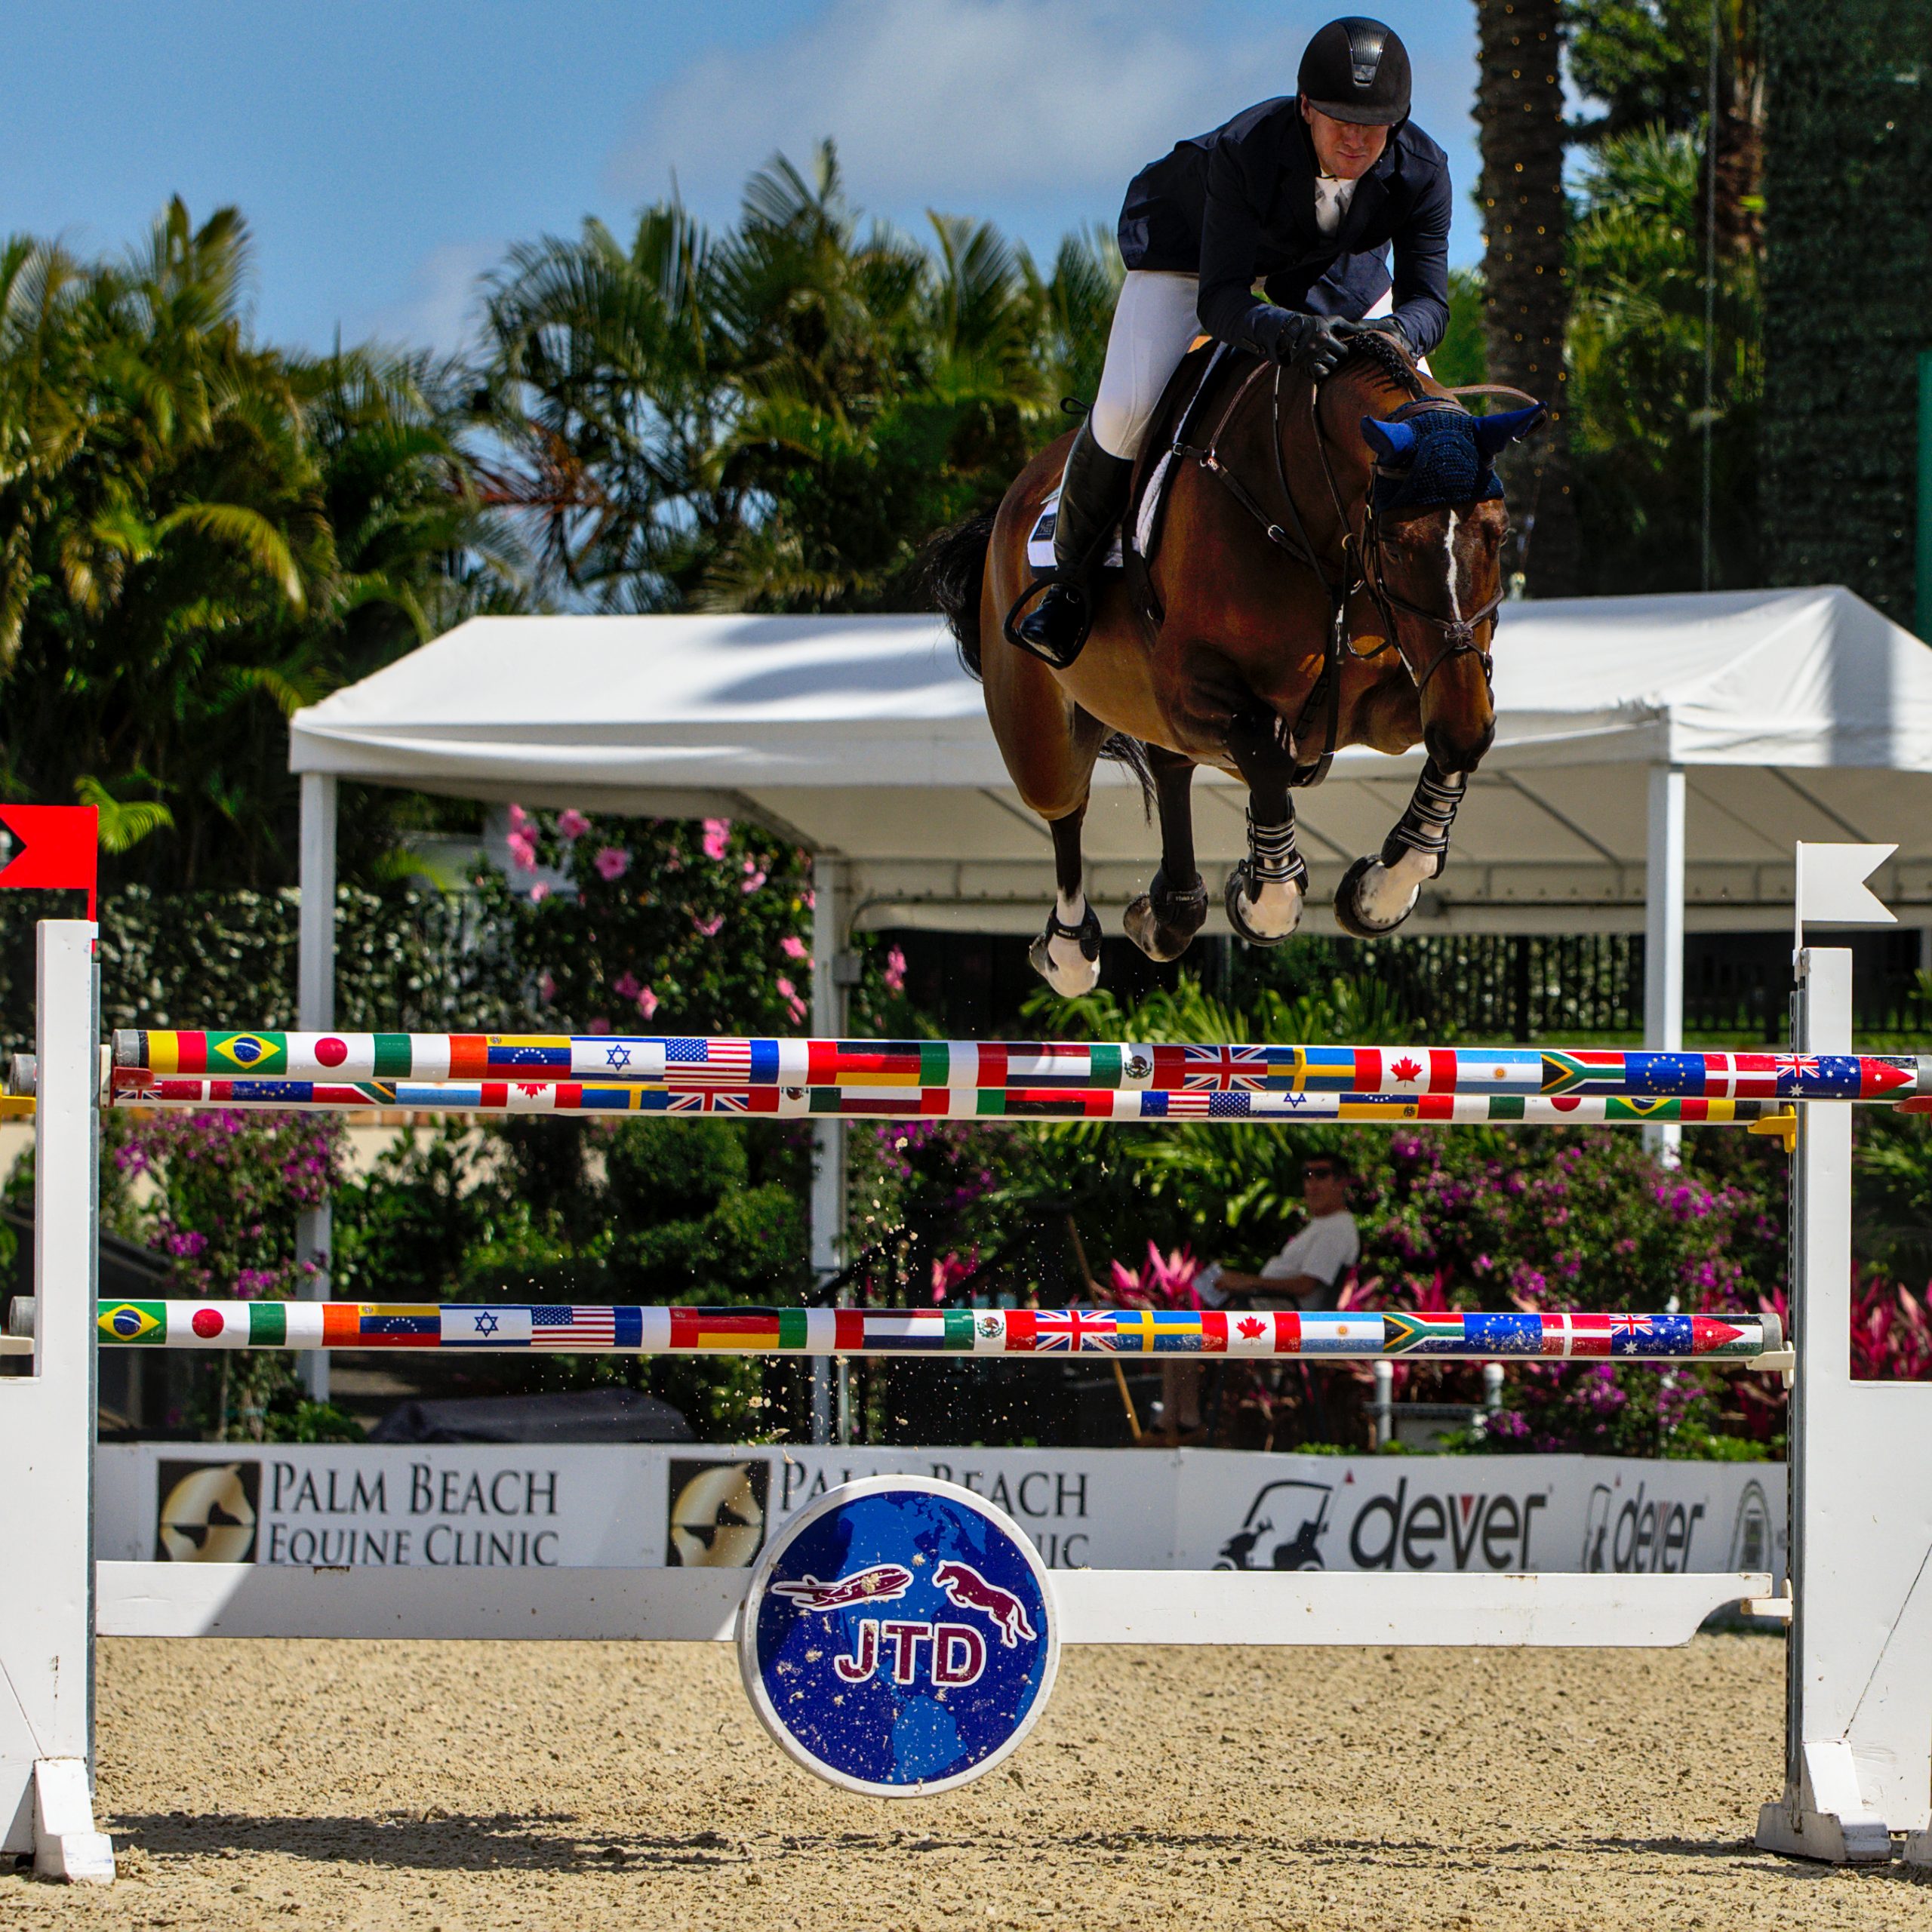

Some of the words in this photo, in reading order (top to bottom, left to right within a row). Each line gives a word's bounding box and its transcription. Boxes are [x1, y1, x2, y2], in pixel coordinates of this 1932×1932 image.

[270, 1460, 389, 1515] PALM
[410, 1463, 559, 1516] BEACH
[780, 1460, 903, 1512] PA
[1349, 1476, 1547, 1570] dever
[833, 1620, 986, 1687] JTD
